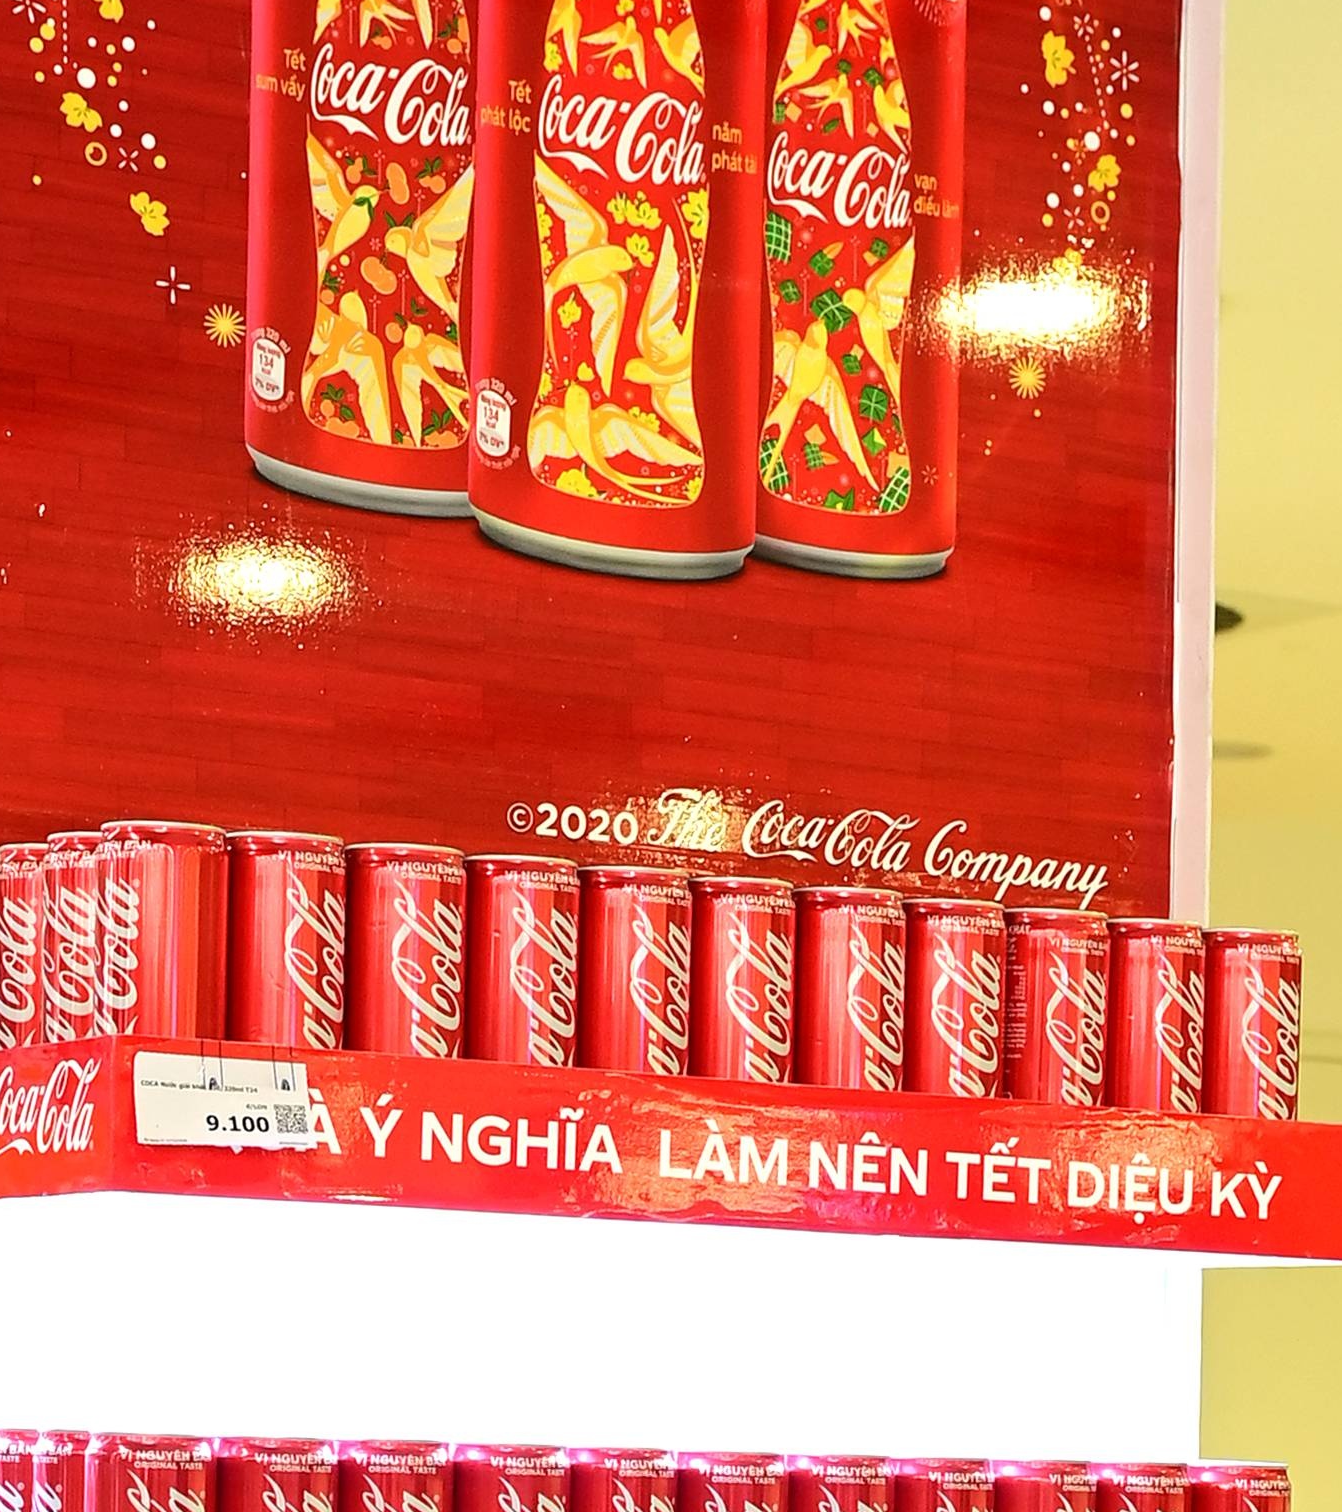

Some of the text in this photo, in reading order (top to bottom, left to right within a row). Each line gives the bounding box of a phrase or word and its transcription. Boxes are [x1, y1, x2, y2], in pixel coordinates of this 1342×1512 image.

[283, 48, 306, 72] Tết
[311, 43, 469, 147] Coca-Cola
[509, 79, 531, 104] Tết
[509, 108, 531, 135] lộc
[536, 74, 705, 186] Coca-Cola
[712, 122, 742, 145] năm
[711, 149, 743, 173] phát
[768, 131, 910, 229] Coca-Cola
[914, 172, 937, 195] vạn
[742, 800, 920, 871] Coca-Cola
[923, 819, 1109, 910] Company
[206, 1114, 269, 1132] 9.100
[365, 1094, 412, 1159] Ý
[421, 1107, 622, 1174] NGHĨA
[659, 1128, 788, 1187] LÀM
[809, 1131, 927, 1198] NÊN
[946, 1137, 1051, 1204] TẾT
[1068, 1154, 1195, 1225] DIỆU
[1210, 1162, 1283, 1221] KỲ
